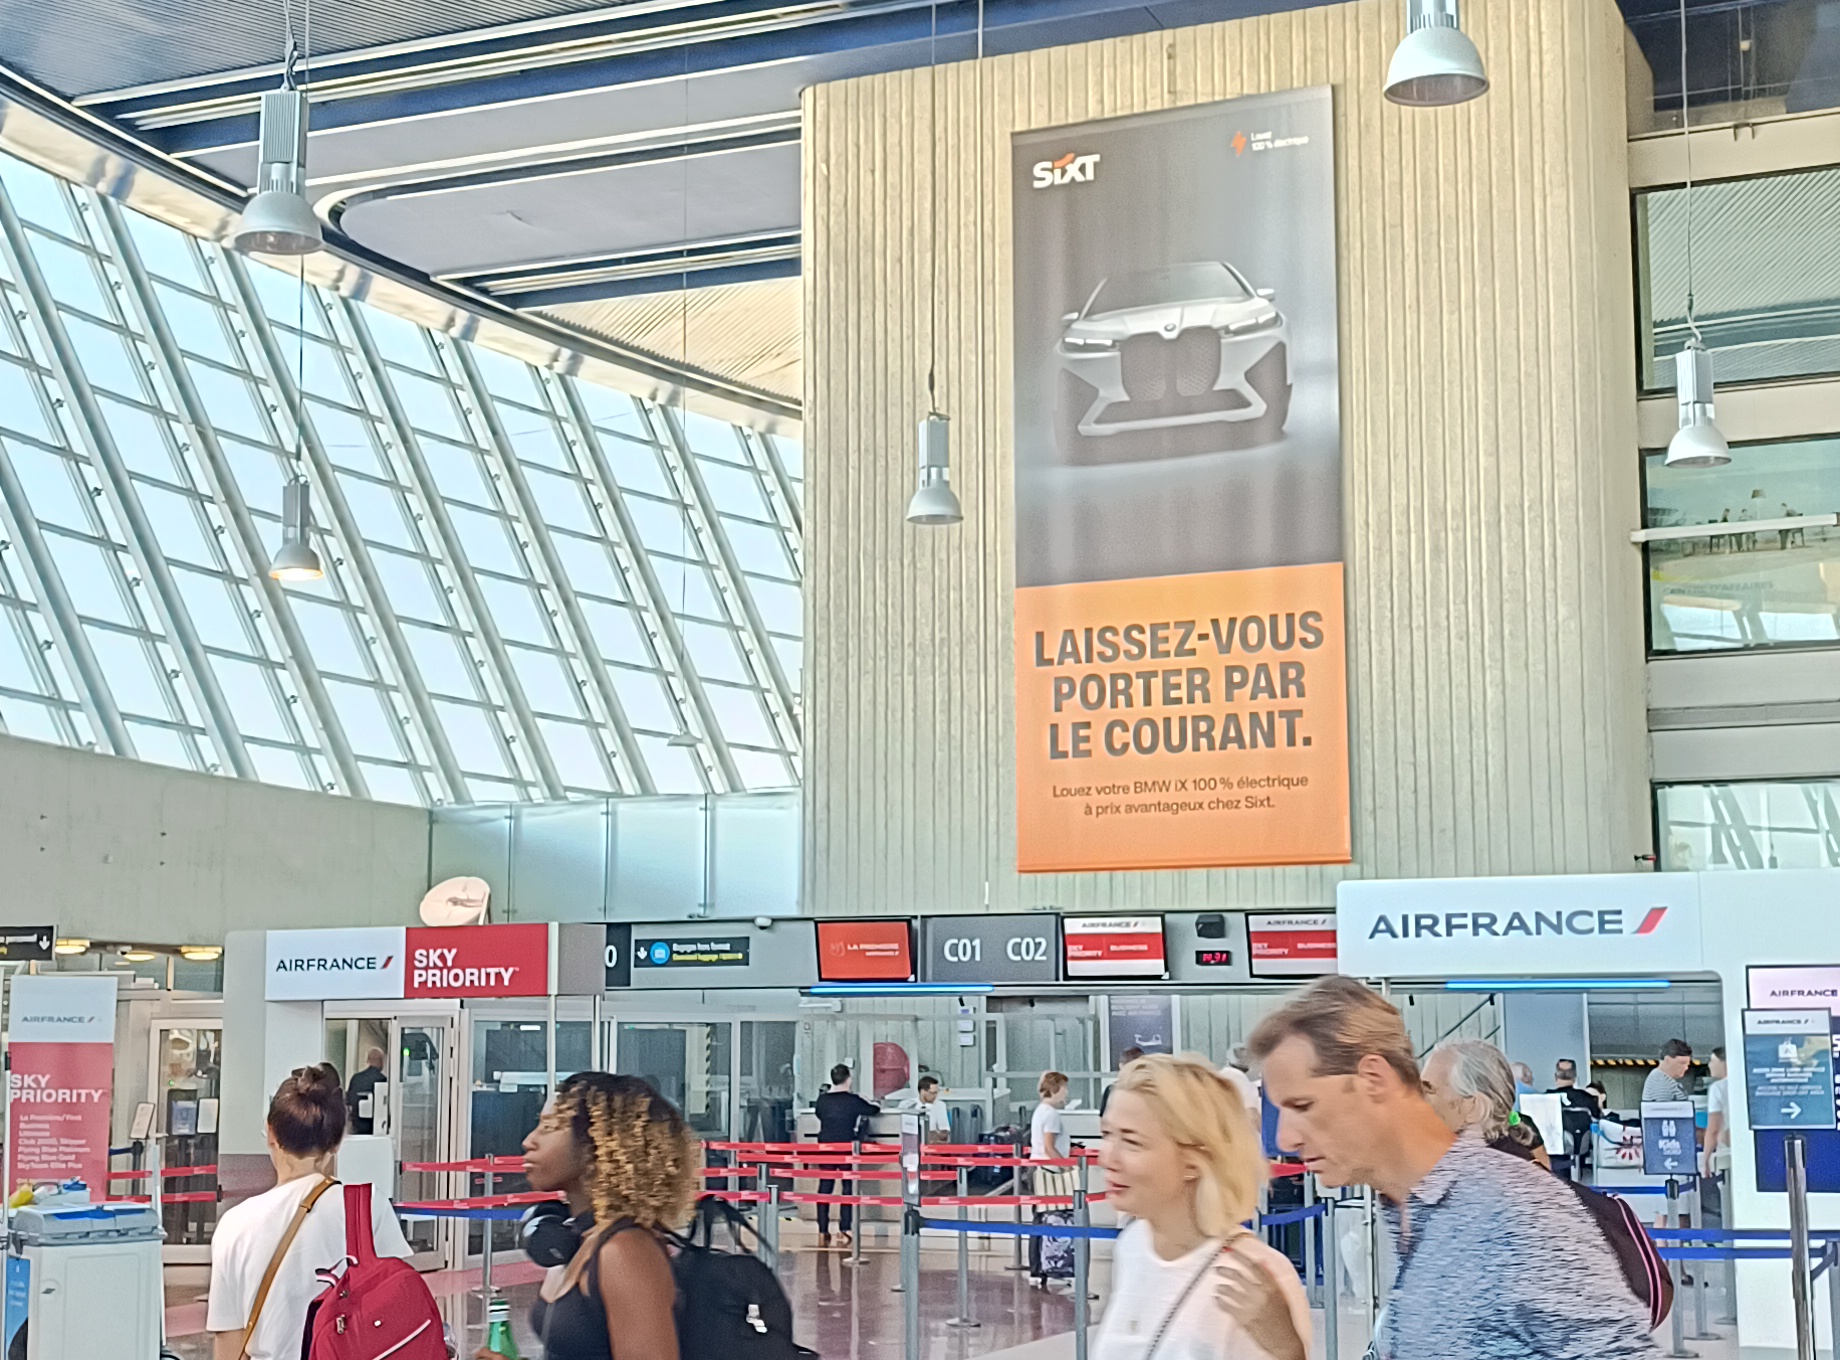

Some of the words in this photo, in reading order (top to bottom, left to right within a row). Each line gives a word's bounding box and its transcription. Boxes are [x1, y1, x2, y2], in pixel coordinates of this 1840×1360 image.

[1035, 611, 1324, 667] LAISSEZ-VOUS
[1053, 667, 1211, 713] PORTER
[1224, 661, 1306, 702] PAR
[1050, 721, 1092, 760] LE
[1104, 709, 1312, 757] COURANT.
[1052, 784, 1093, 798] Louez
[1095, 783, 1131, 796] votre
[1133, 780, 1172, 794] BMW
[1175, 778, 1189, 792] iX
[1192, 777, 1218, 791] 100
[1219, 776, 1234, 790] %
[1237, 774, 1309, 791] électrique
[1084, 802, 1093, 816] à
[1096, 801, 1122, 818] prix
[1124, 799, 1204, 816] avantageux
[1208, 796, 1242, 810] chez
[1244, 795, 1275, 809] Sixt.
[1368, 909, 1623, 940] AIRFRANCE
[413, 948, 457, 968] SKY
[944, 938, 981, 962] C01
[1007, 937, 1047, 961] C02
[275, 956, 377, 972] AIRFRANCE
[413, 967, 515, 988] PRIORITY
[1769, 989, 1838, 997] AIRFRANCE
[10, 1073, 51, 1088] SKY
[10, 1089, 103, 1103] PRIORITY
